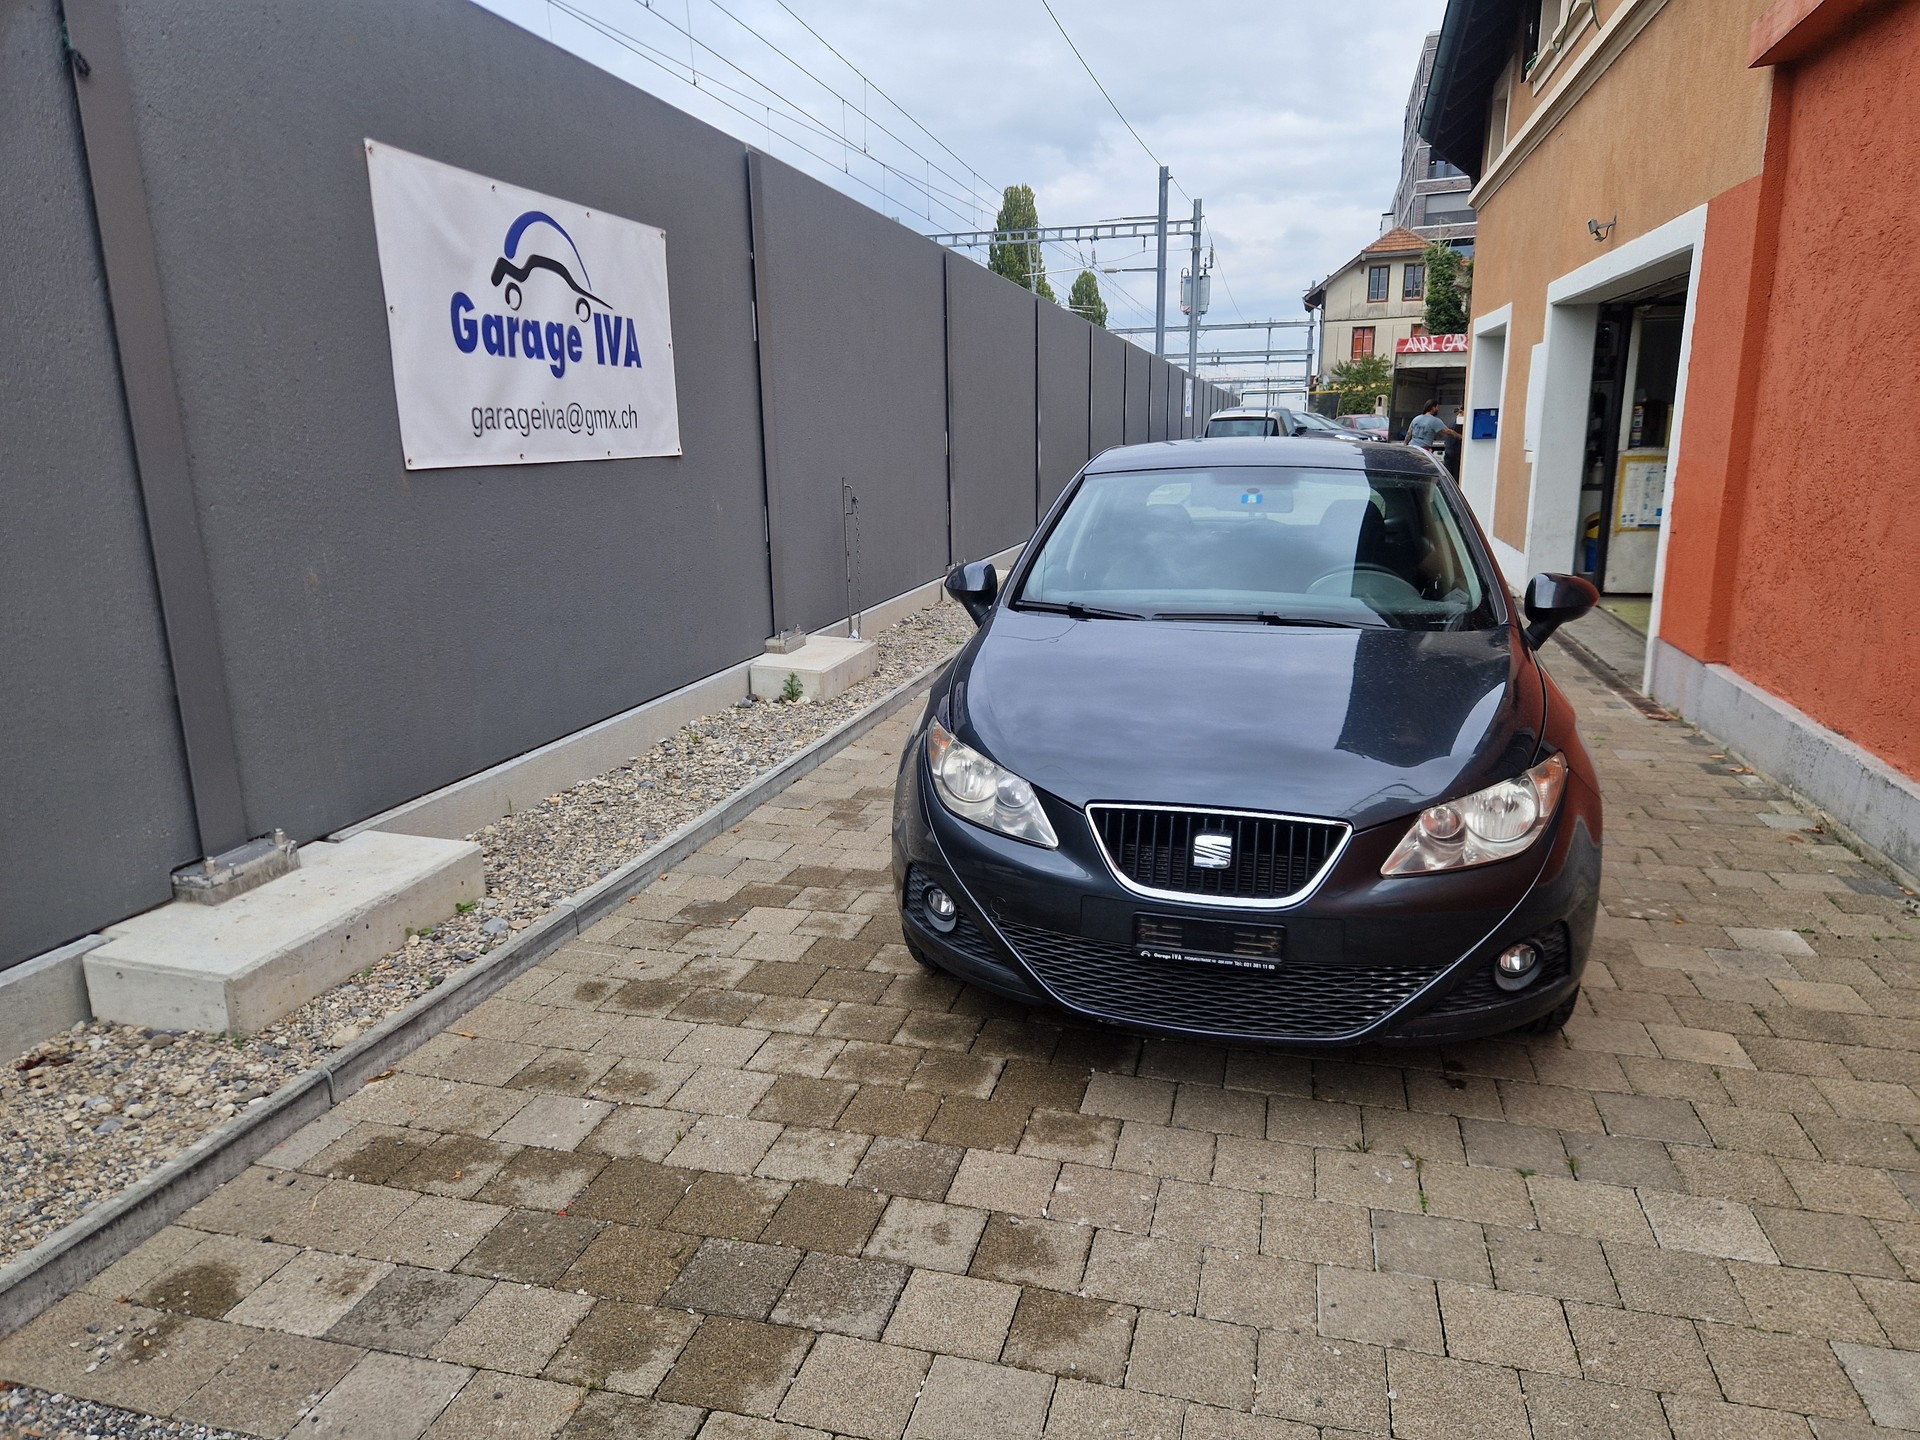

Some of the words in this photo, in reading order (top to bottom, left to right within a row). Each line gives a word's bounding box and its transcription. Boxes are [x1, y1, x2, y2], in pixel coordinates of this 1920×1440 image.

[450, 291, 582, 379] Garage
[593, 312, 642, 369] IVA
[1403, 335, 1440, 352] AARE
[471, 402, 638, 437] garageiva@gmx.ch
[1153, 952, 1171, 960] Garage
